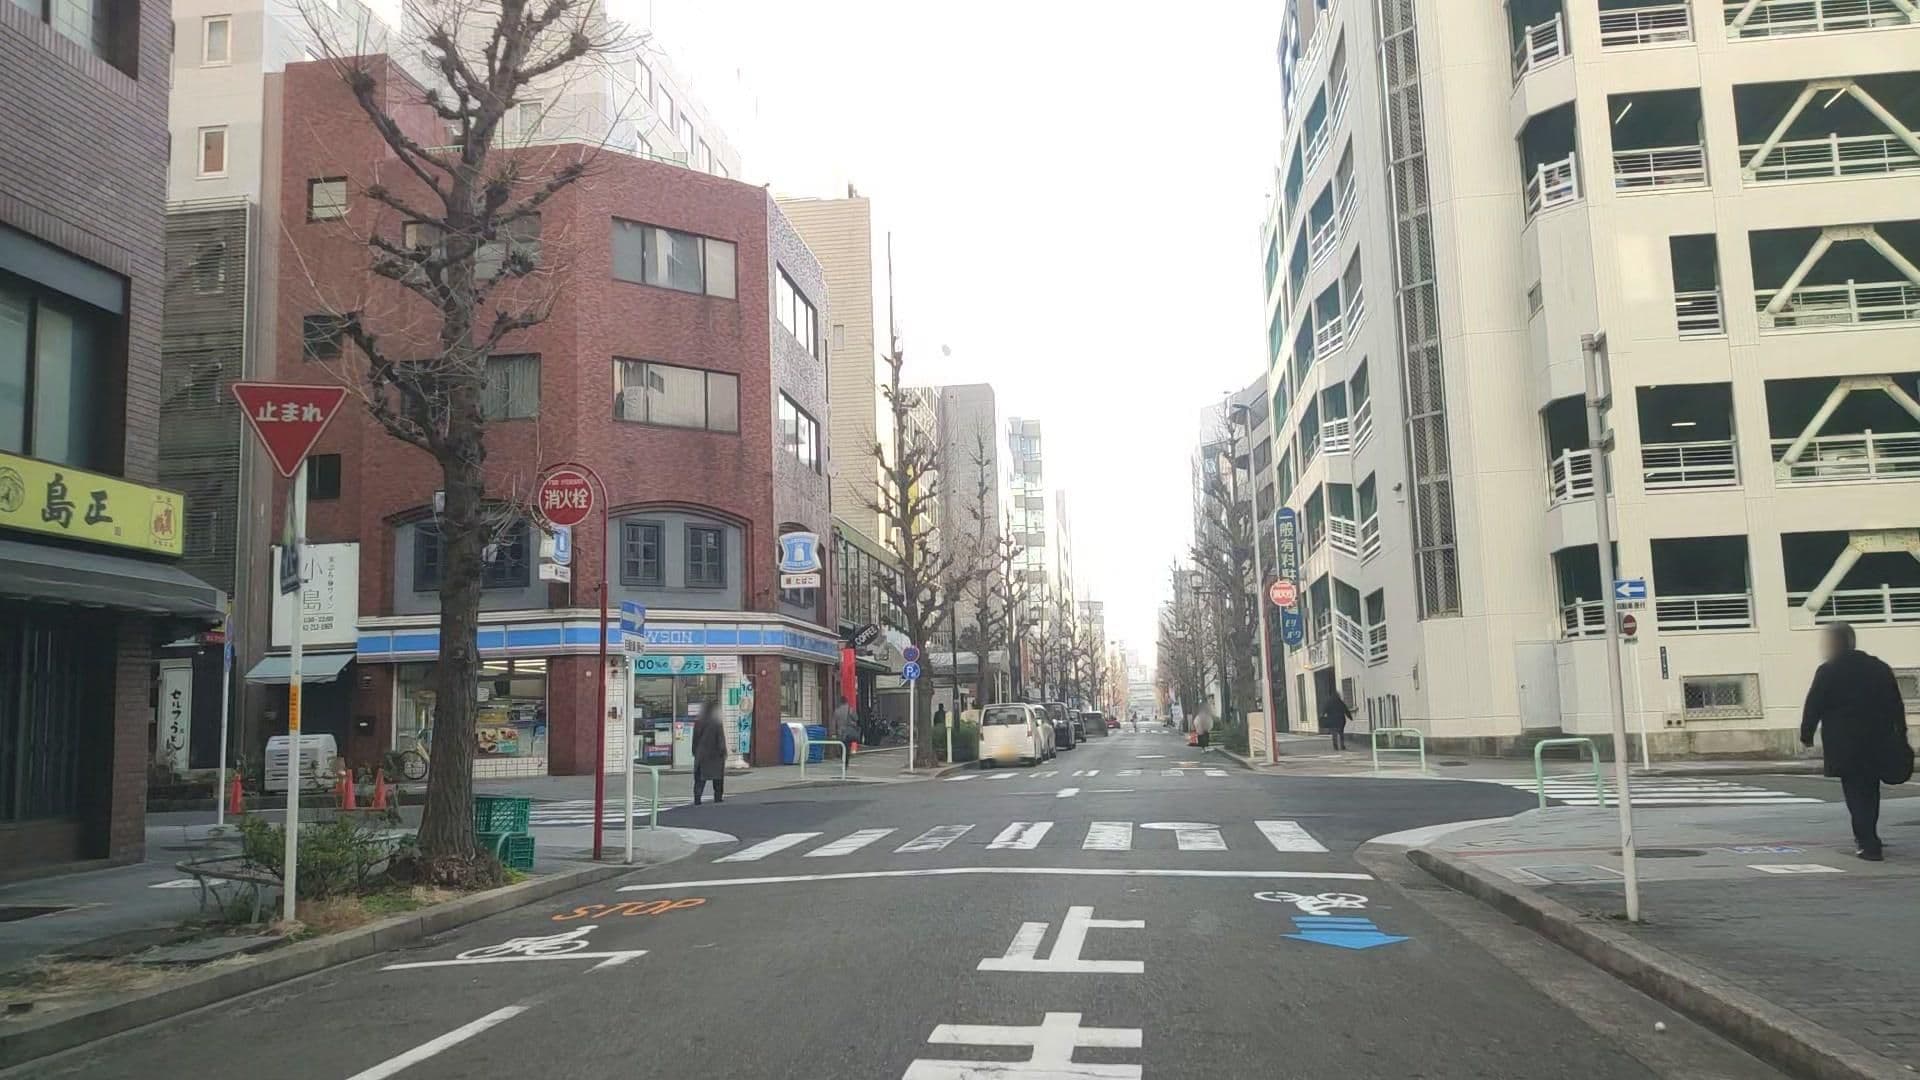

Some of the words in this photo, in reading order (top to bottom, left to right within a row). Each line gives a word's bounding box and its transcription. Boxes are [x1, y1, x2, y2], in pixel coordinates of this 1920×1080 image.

[256, 401, 323, 422] 止まれ
[41, 473, 113, 528] 島正
[545, 488, 589, 509] 消火栓
[304, 557, 323, 611] 小島
[645, 631, 693, 643] WSON
[854, 625, 878, 646] COFFEE
[552, 898, 706, 920] STOP
